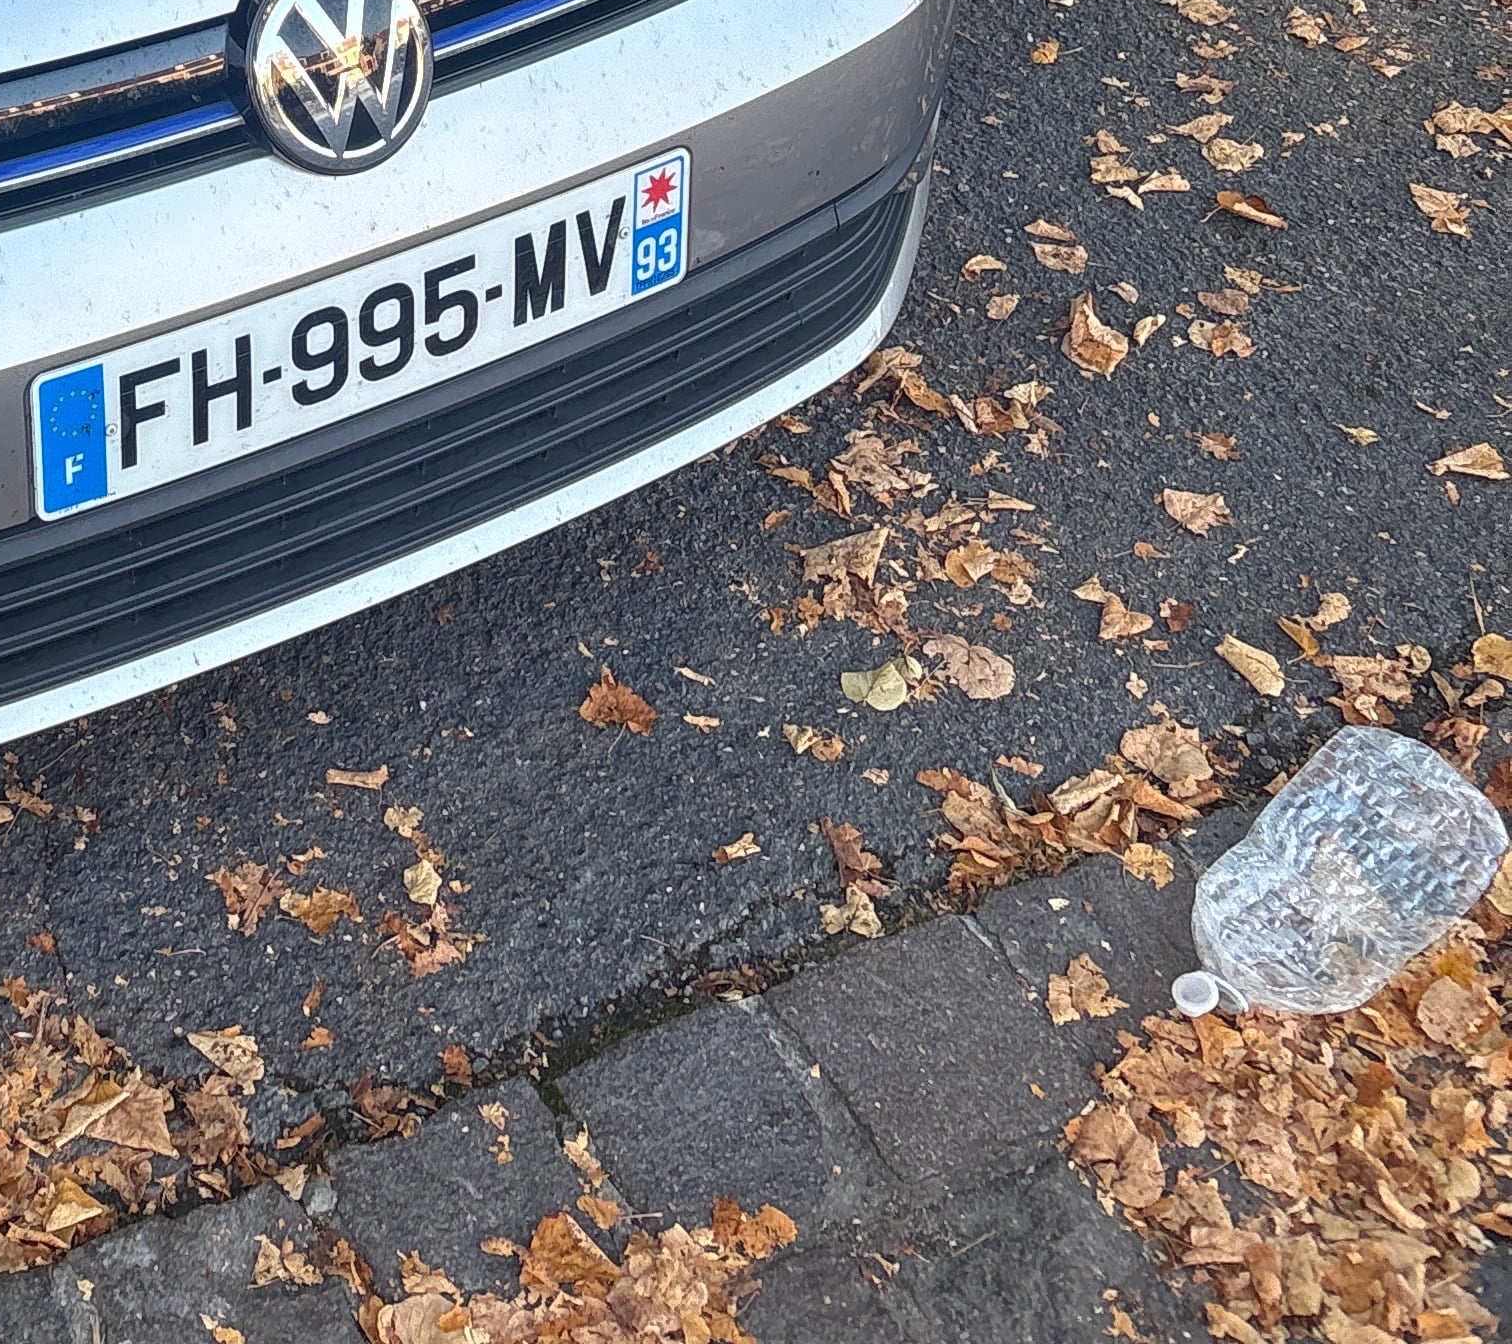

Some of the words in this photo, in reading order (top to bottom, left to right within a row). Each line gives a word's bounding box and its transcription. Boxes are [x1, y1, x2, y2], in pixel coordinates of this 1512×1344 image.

[64, 452, 84, 485] F
[119, 195, 627, 471] FH-995-MV
[635, 227, 678, 282] 93
